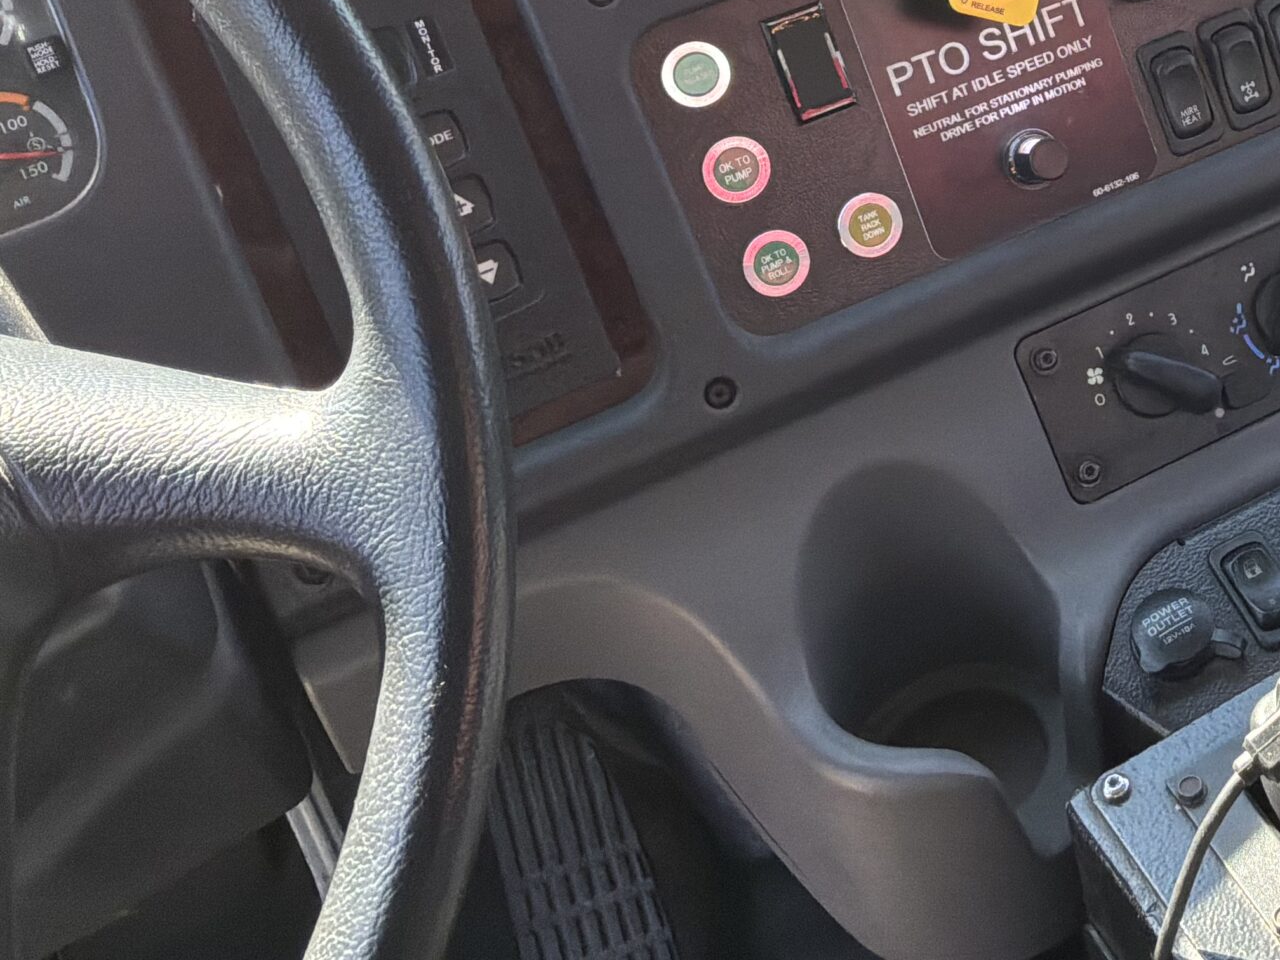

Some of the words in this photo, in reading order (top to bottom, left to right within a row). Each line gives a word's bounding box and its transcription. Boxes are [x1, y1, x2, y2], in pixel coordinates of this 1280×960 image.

[971, 0, 1005, 15] RELEASE
[31, 47, 53, 59] MODE
[414, 19, 442, 73] MONITOR
[37, 61, 60, 74] RESET
[886, 41, 970, 97] PTO
[907, 95, 949, 118] SHIFT
[952, 83, 968, 102] AT
[972, 71, 1004, 93] IDLE
[1007, 51, 1054, 79] SPEED
[1057, 35, 1093, 59] ONLY
[913, 112, 965, 139] NEUTRAL
[965, 102, 989, 118] FOR
[990, 77, 1054, 110] STATIONARY
[1055, 58, 1103, 86] PUMPING
[940, 121, 975, 142] DRIVE
[975, 110, 999, 128] FOR
[999, 98, 1030, 120] PUMP
[1031, 94, 1044, 106] IN
[1045, 77, 1086, 102] MOTION
[1181, 104, 1200, 118] MIRR
[0, 116, 27, 135] 100
[1182, 112, 1202, 127] HEAT
[20, 161, 48, 180] 150
[719, 162, 734, 174] OK
[736, 154, 751, 167] TO
[725, 168, 752, 185] PUMP
[13, 196, 31, 209] AIR
[858, 210, 878, 222] TANK
[861, 218, 881, 232] RACK
[862, 226, 885, 241] DOWN
[760, 254, 772, 264] OK
[772, 248, 786, 260] TO
[761, 259, 785, 274] PUMP
[768, 267, 790, 280] ROLL
[1126, 313, 1135, 326] 2
[1168, 313, 1177, 325] 3
[1201, 344, 1210, 356] 4
[1142, 597, 1190, 628] POWER
[1147, 605, 1193, 637] OUTLET
